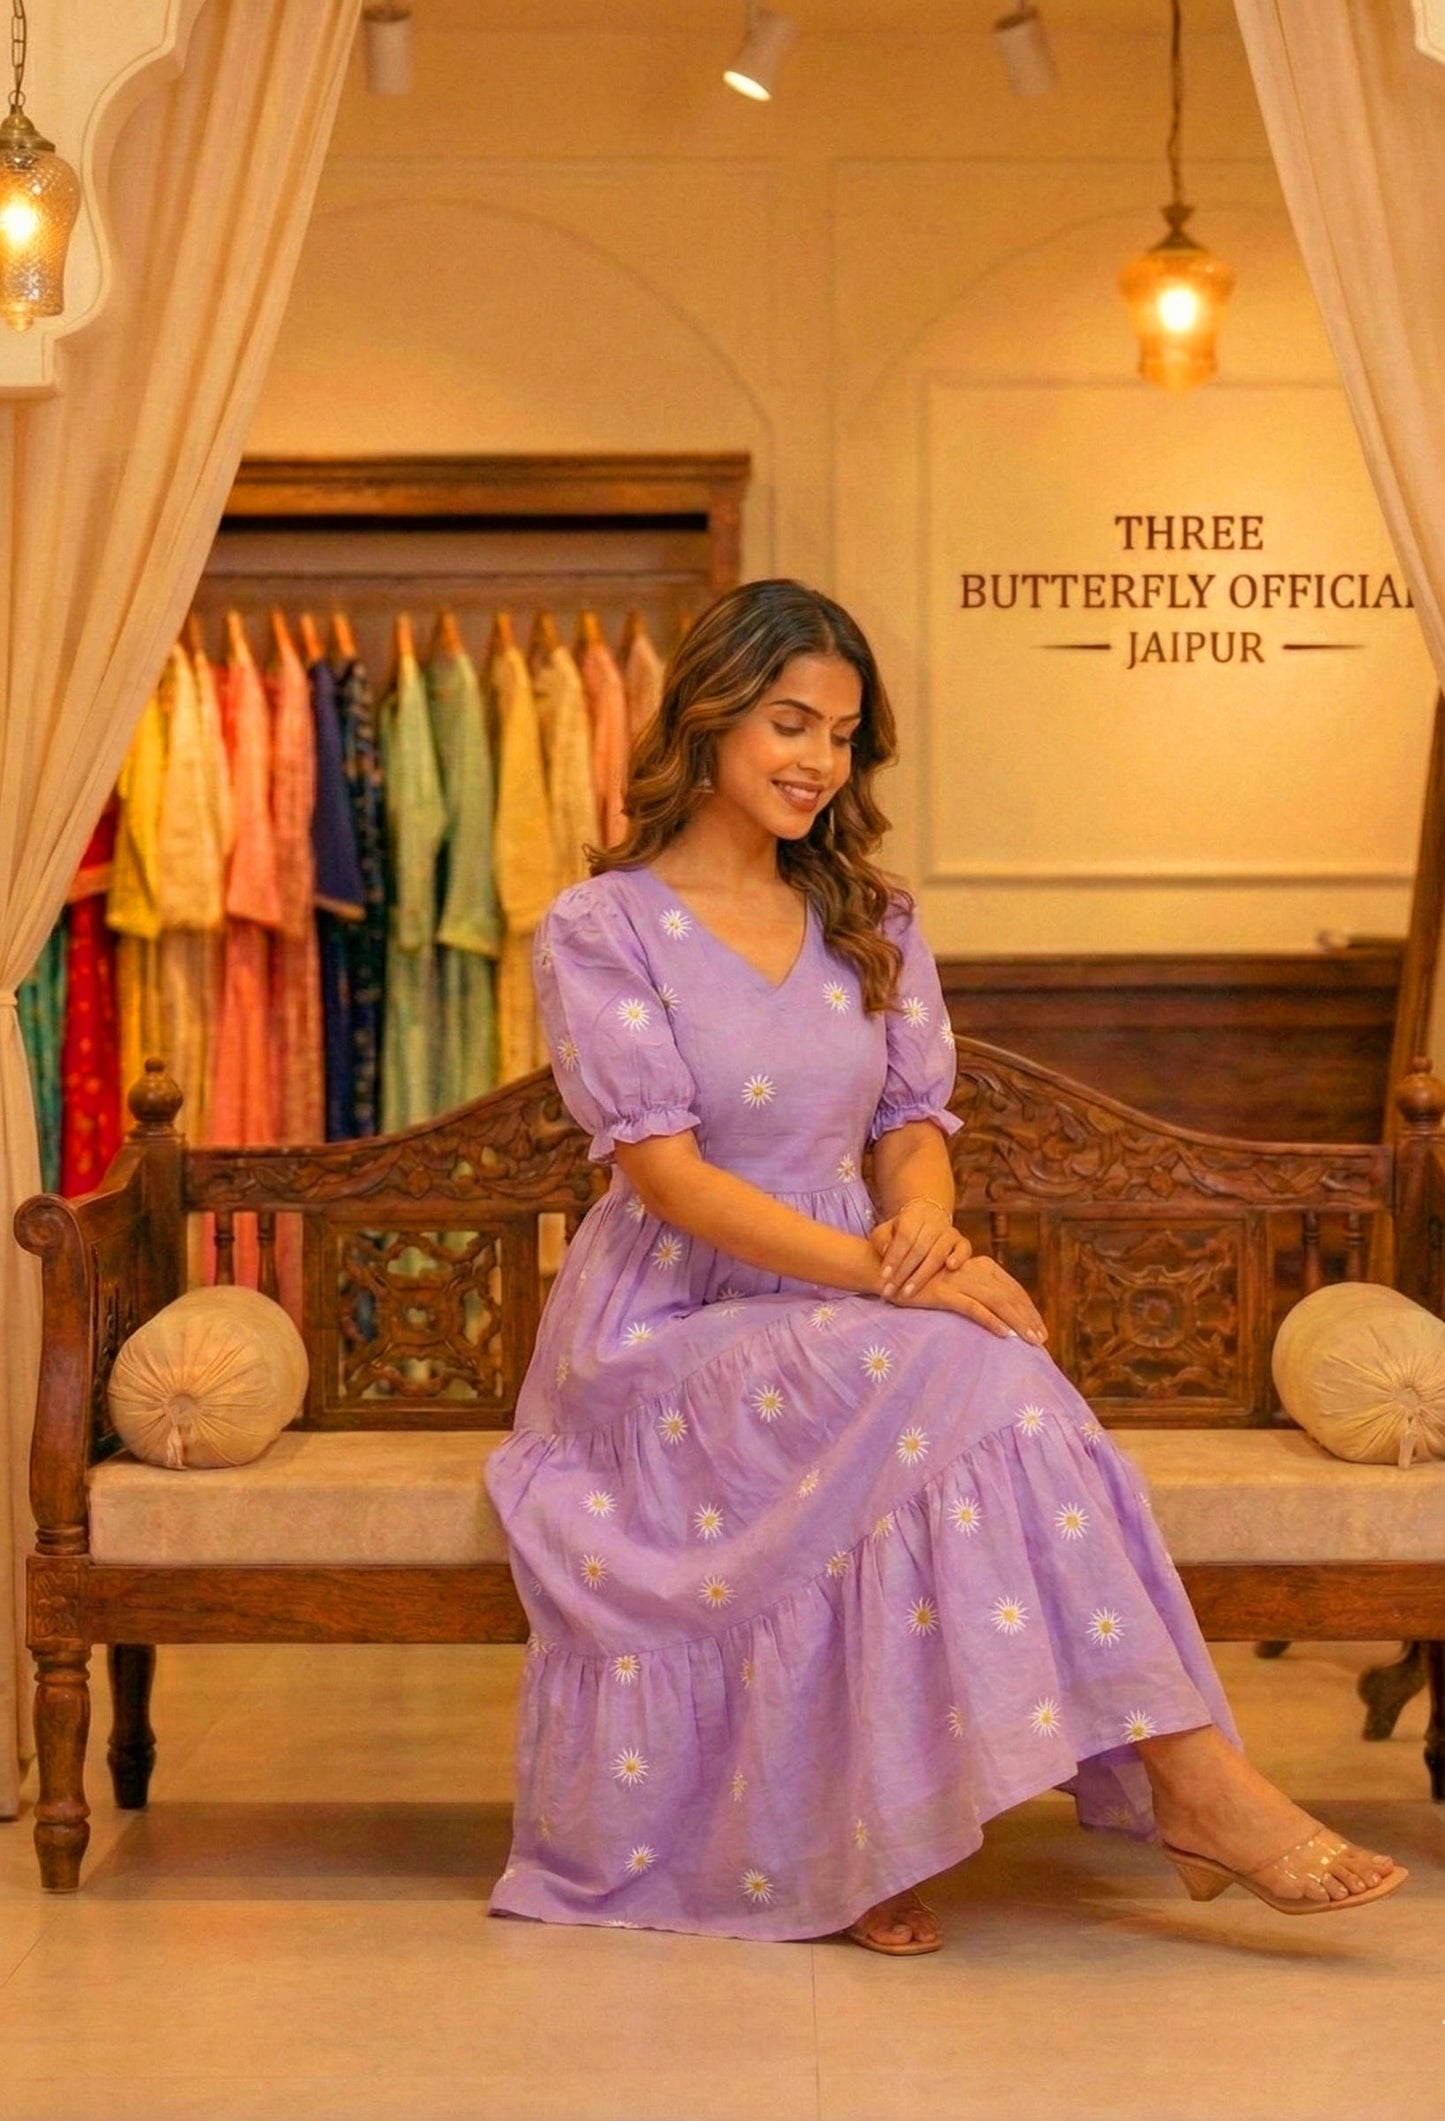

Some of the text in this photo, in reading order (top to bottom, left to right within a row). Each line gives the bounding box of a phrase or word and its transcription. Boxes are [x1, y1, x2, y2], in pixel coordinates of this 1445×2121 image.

[1115, 515, 1264, 551] THREE
[959, 573, 1216, 609] BUTTERFLY
[1126, 631, 1266, 670] JAIPUR
